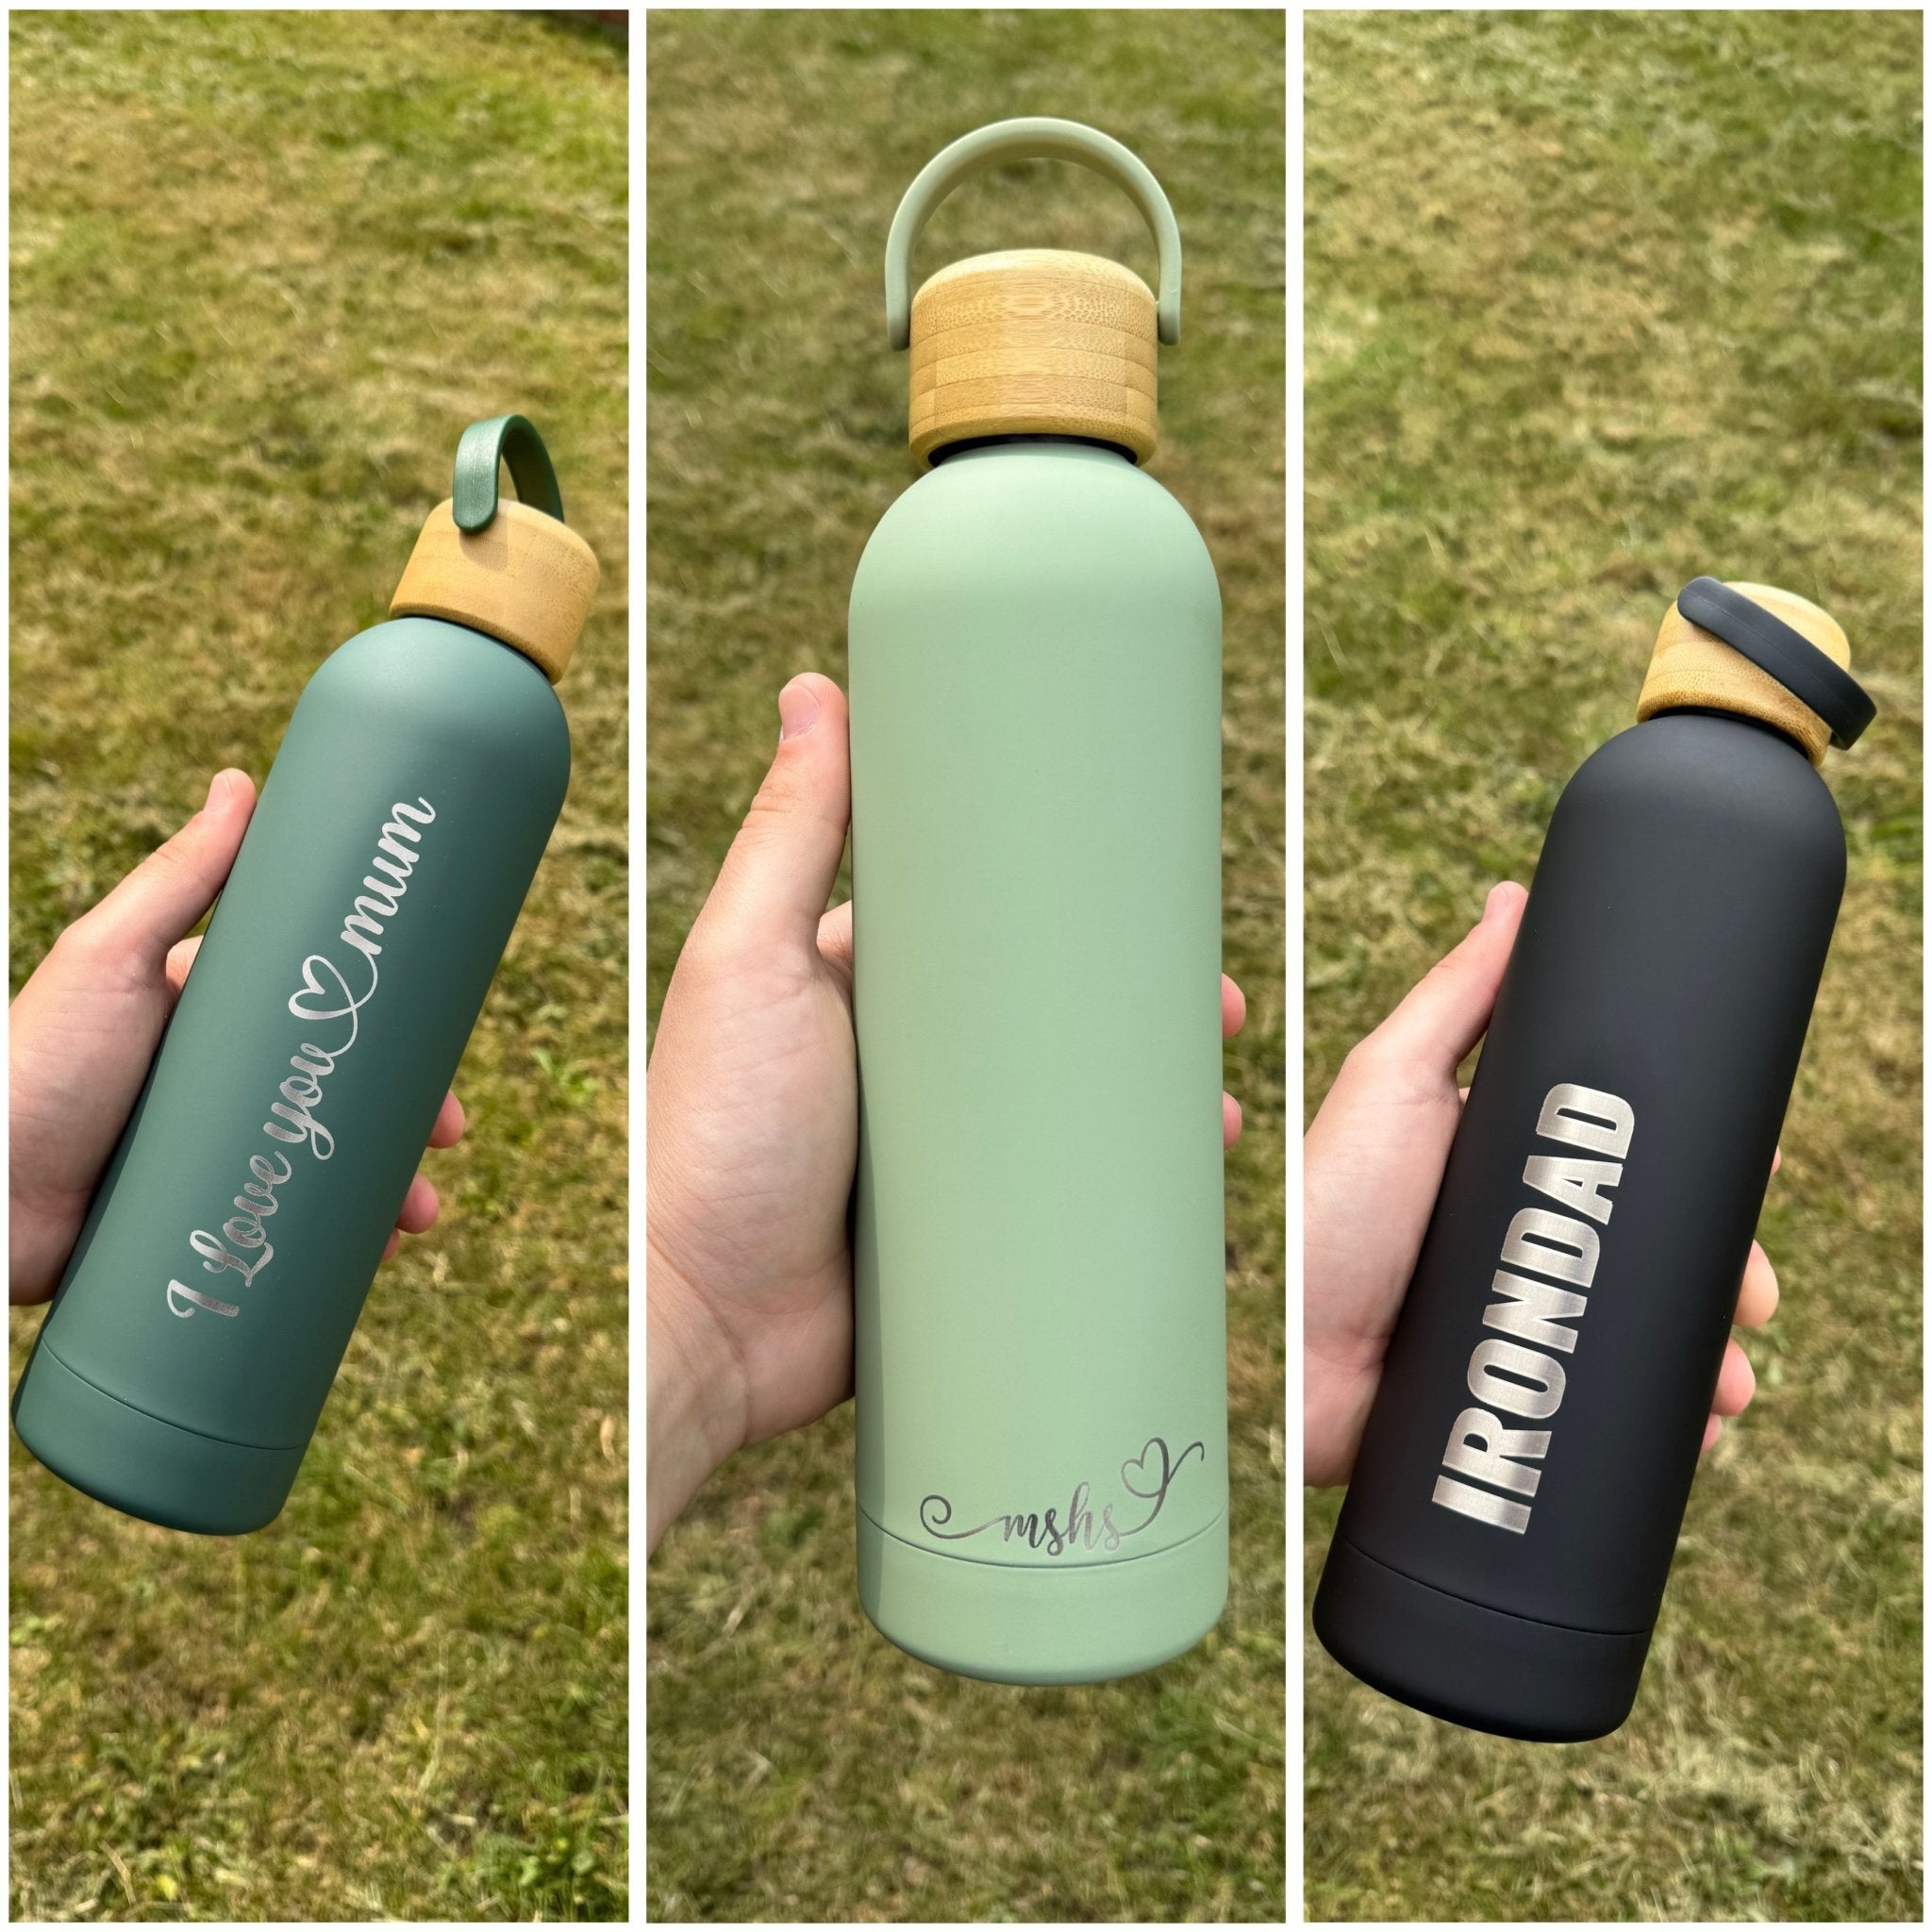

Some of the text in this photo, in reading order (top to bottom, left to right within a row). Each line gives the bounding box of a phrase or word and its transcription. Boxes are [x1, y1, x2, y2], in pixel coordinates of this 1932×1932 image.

[166, 796, 437, 1319] I Love you mum
[1431, 1082, 1636, 1536] IRONDAD
